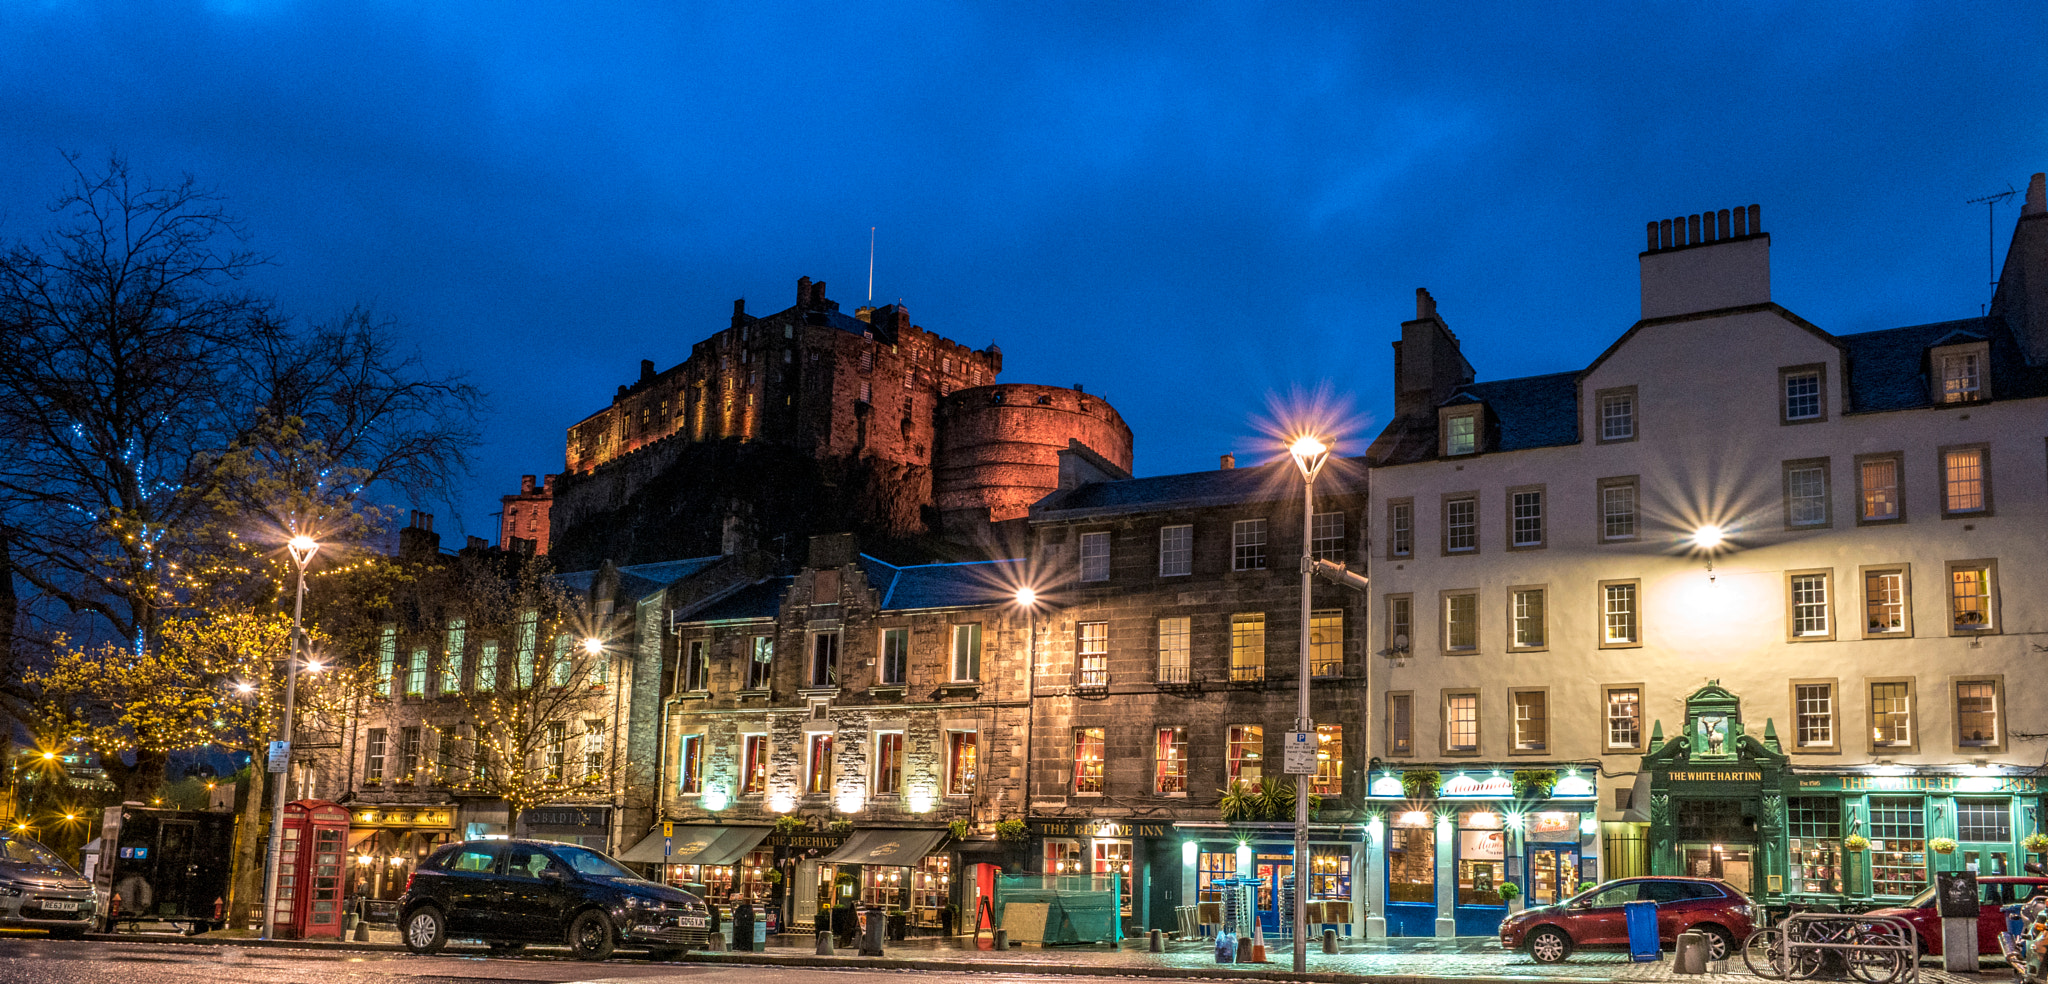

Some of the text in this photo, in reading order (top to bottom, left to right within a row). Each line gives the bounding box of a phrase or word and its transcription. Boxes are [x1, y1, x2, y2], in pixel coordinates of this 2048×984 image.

[1668, 771, 1761, 781] THE WHITE HART INN
[1839, 776, 1873, 790] THE
[1041, 823, 1069, 835] THE
[1140, 824, 1164, 836] INN
[766, 836, 786, 846] THE
[791, 836, 838, 848] BEEHIVE
